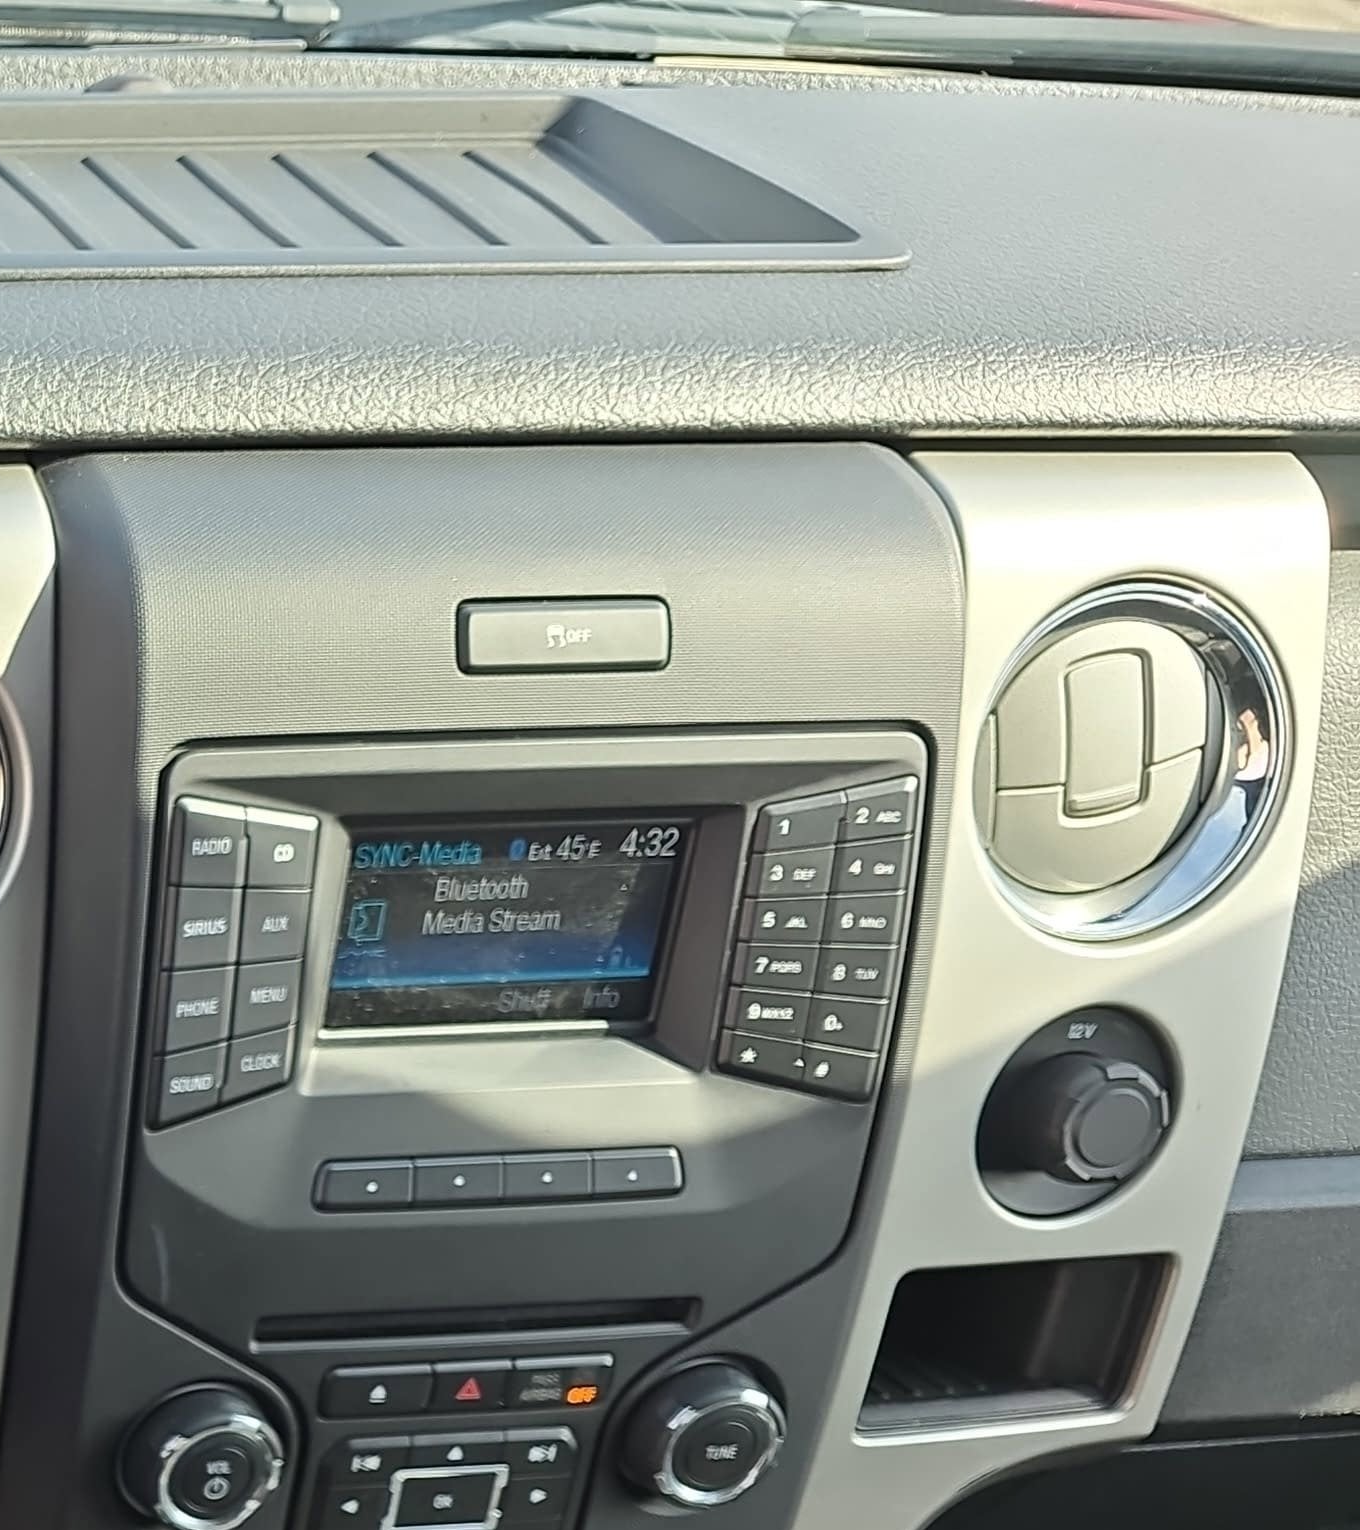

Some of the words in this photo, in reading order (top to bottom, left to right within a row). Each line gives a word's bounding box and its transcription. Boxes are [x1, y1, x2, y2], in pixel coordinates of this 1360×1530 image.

[566, 629, 592, 643] OFF
[856, 807, 870, 824] 2
[778, 818, 791, 835] 1
[192, 837, 232, 856] RADIO
[353, 841, 483, 868] SYNC-Media
[620, 826, 680, 858] 4:32
[769, 864, 784, 881] 3
[848, 859, 863, 875] 4
[434, 875, 529, 902] Bluetooth
[183, 918, 228, 938] SIRIUS
[261, 916, 289, 933] AUX
[422, 910, 484, 935] Media
[488, 907, 561, 933] Stream
[761, 912, 776, 928] 5
[840, 912, 854, 929] 6
[755, 957, 769, 974] 7
[176, 998, 219, 1018] PHONE
[747, 1003, 762, 1020] 9
[240, 1054, 280, 1073] CLOCK
[169, 1073, 214, 1093] SOUND
[567, 1386, 597, 1404] OFF
[705, 1444, 739, 1460] TUNE
